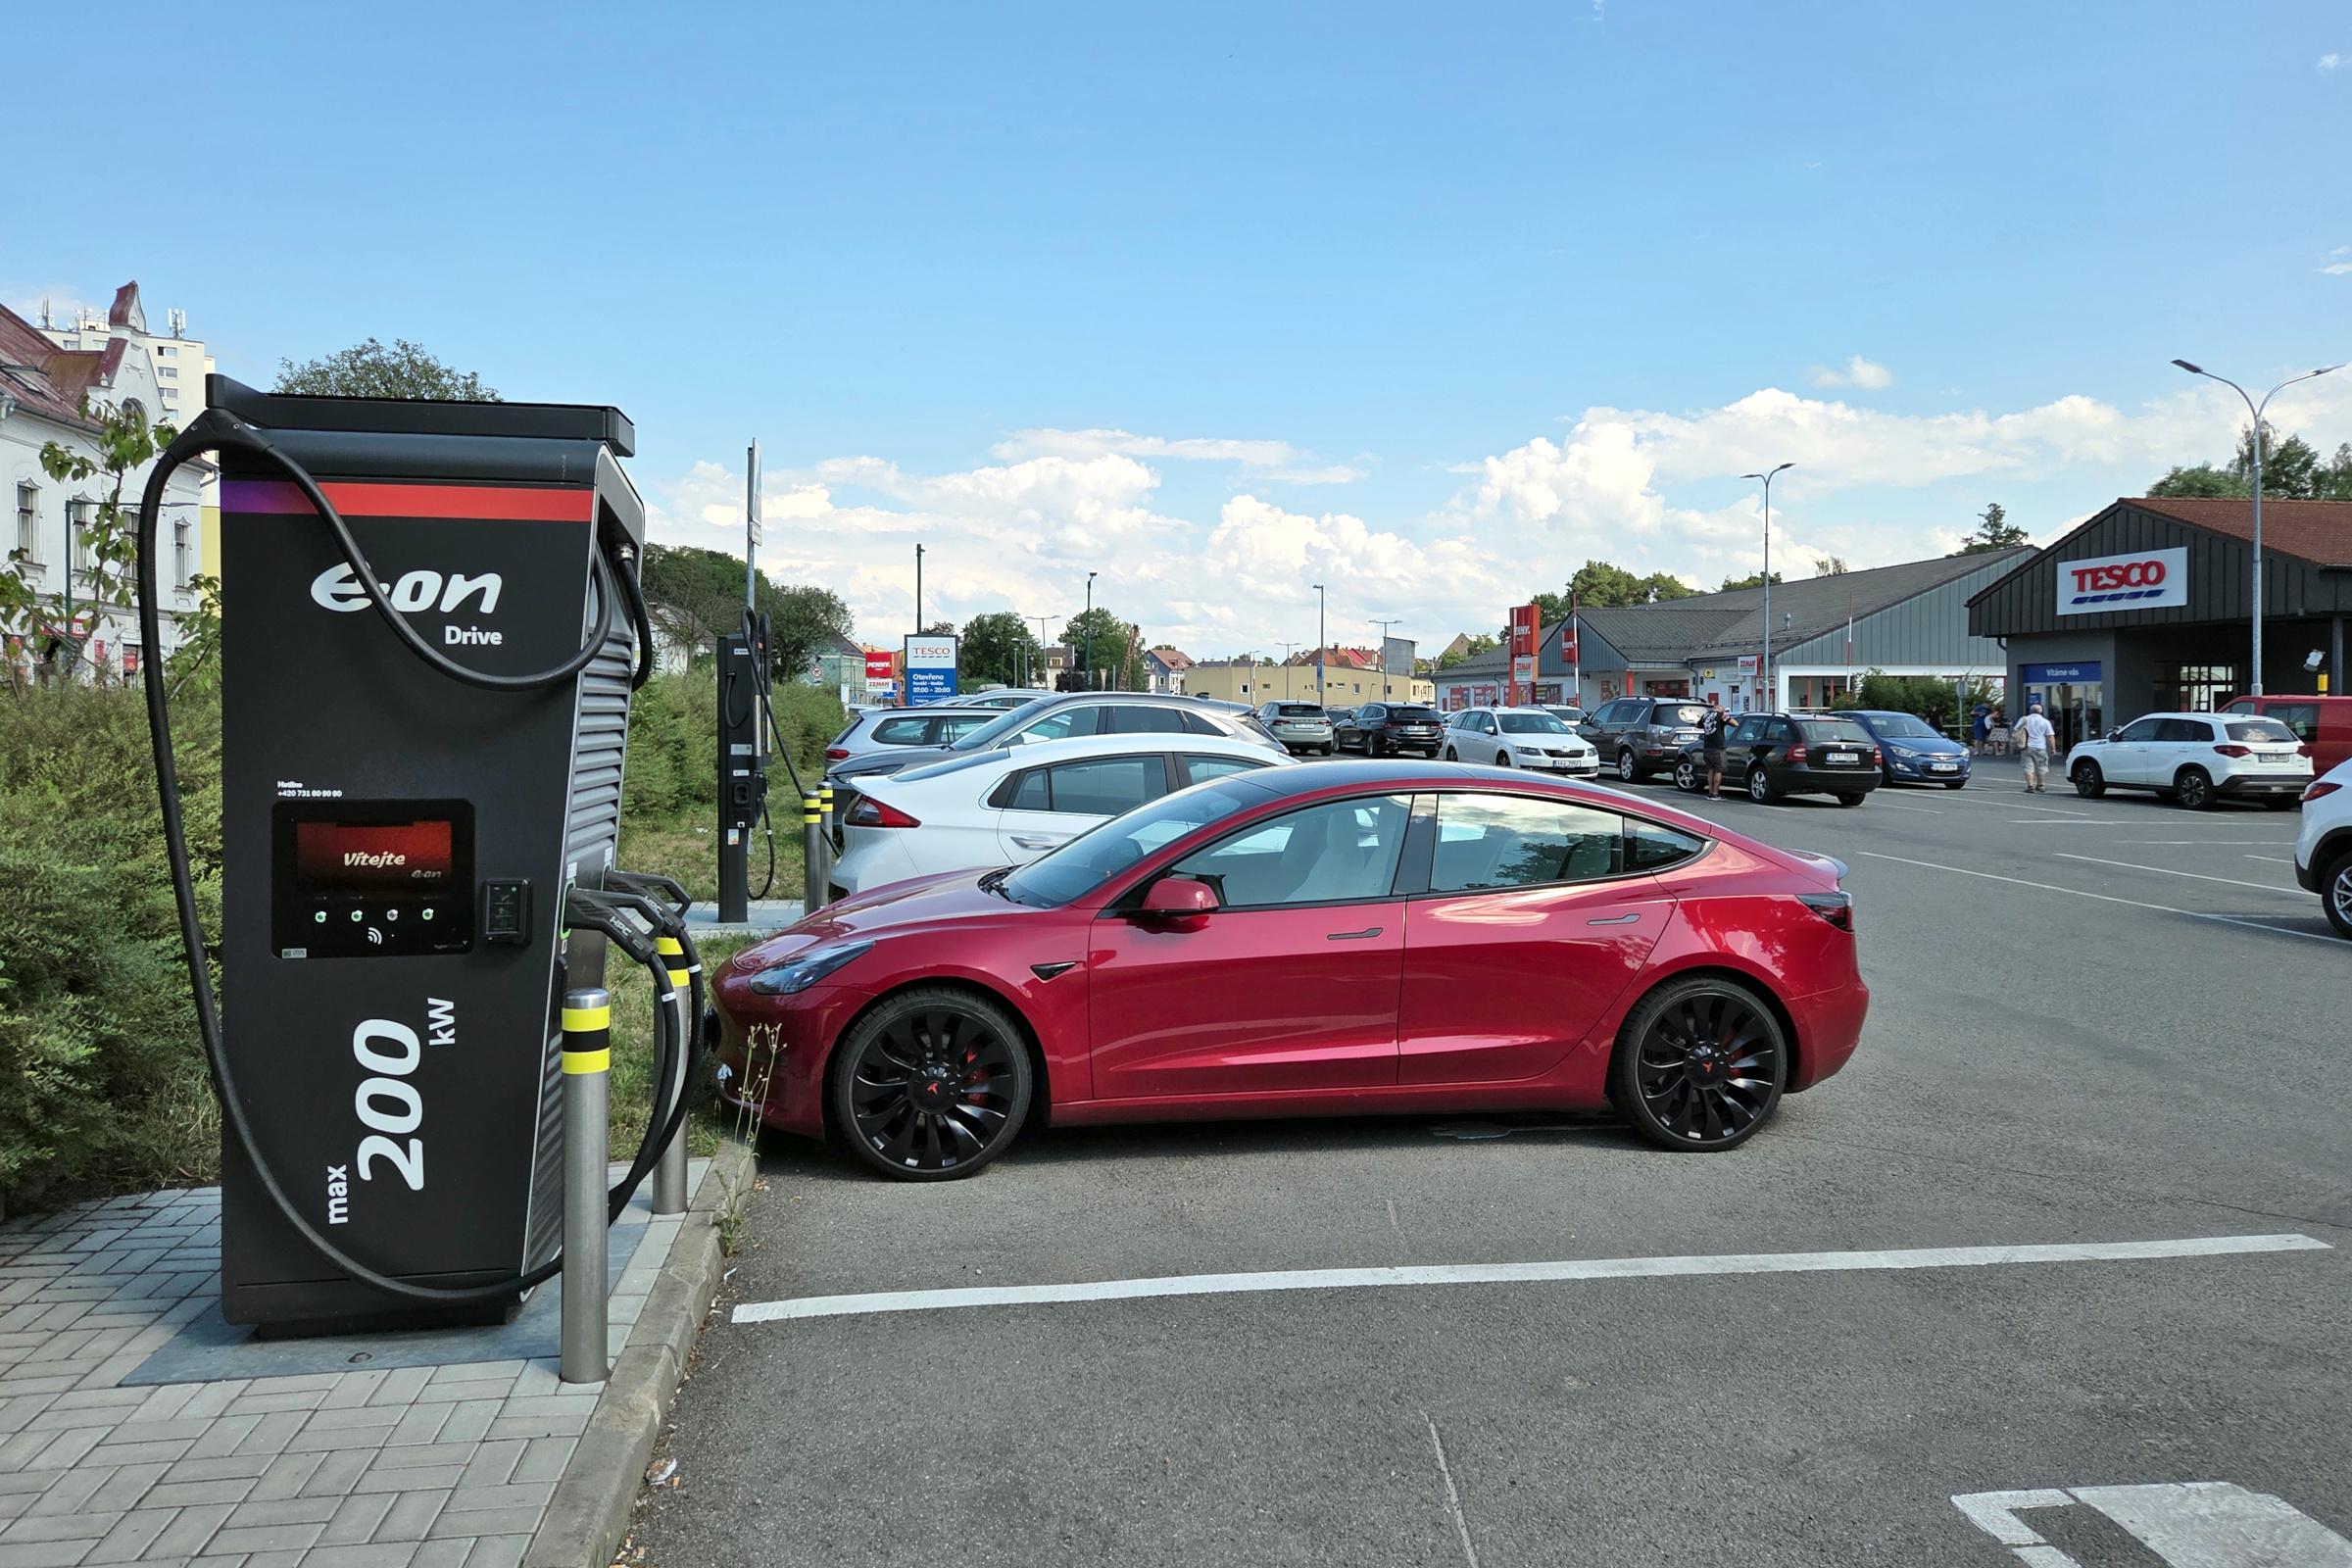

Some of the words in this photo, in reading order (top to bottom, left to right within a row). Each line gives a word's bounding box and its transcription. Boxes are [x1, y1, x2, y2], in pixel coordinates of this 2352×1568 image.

[2071, 561, 2166, 592] TESCO
[445, 625, 503, 645] Drive
[343, 851, 406, 868] Vítejte
[609, 915, 633, 937] HPC
[327, 1163, 349, 1225] max
[353, 1018, 424, 1191] 200
[427, 997, 456, 1046] kW
